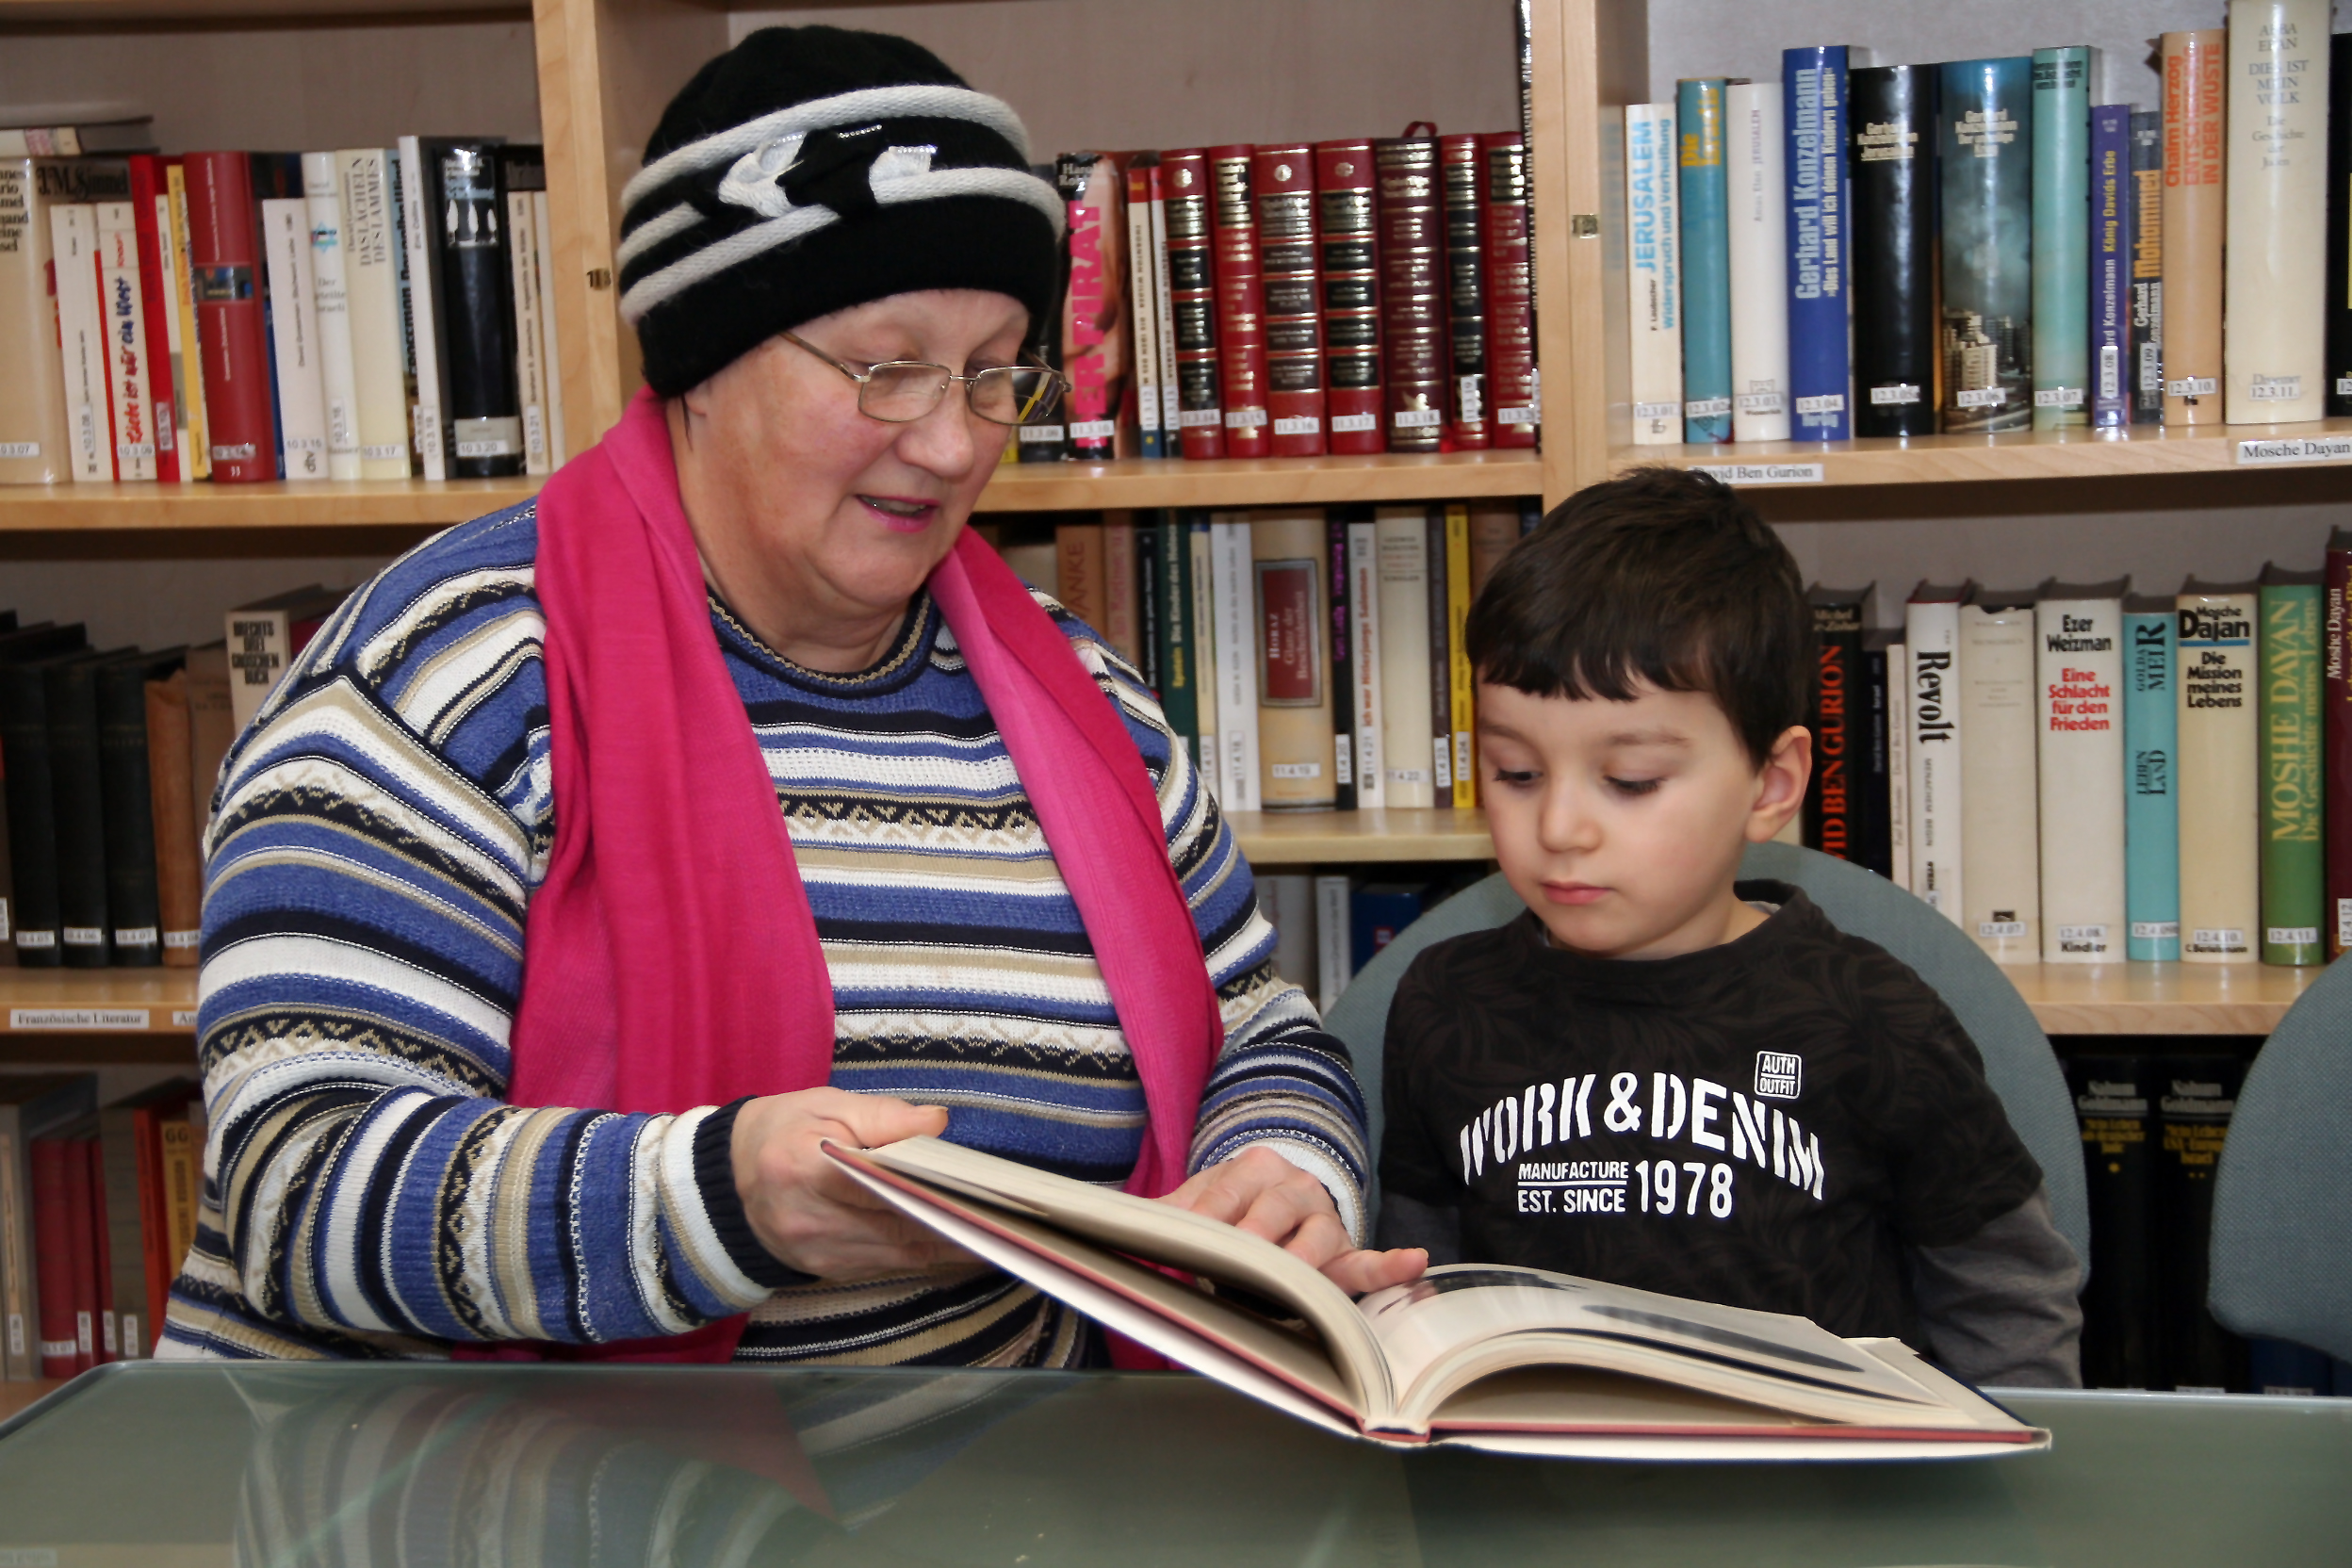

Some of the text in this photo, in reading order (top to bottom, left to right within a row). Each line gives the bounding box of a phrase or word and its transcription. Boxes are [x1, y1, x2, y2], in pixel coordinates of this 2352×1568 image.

[2287, 59, 2309, 73] IST
[2166, 55, 2182, 124] Herzog
[1680, 133, 1700, 167] Die
[1751, 109, 1761, 165] JERUSALEM
[1821, 109, 1838, 155] Kindern
[2202, 121, 2219, 161] DER
[368, 157, 384, 229] LAMMES
[1792, 70, 1821, 300] Gerhard Konzelmann
[1821, 155, 1838, 193] deinen
[2202, 164, 2219, 185] IN
[1633, 121, 1657, 273] JERUSALEM
[1821, 195, 1838, 213] ich
[1658, 119, 1675, 330] Widerspruch und Verheißung
[1822, 215, 1838, 236] will
[2102, 150, 2118, 327] Konzelmann König Davids Erbe
[2133, 169, 2161, 278] Mohammed
[1068, 200, 1105, 346] PIRAT
[1822, 238, 1838, 265] Land
[2134, 282, 2149, 327] Gerhard
[304, 450, 317, 473] dtv
[2244, 440, 2352, 460] Mosche Dayan
[1737, 466, 1813, 479] Ben Gurion
[1066, 544, 1091, 618] ANKE
[1358, 567, 1369, 619] Salomon
[1168, 564, 1186, 688] Epstein Die Kinder des
[2062, 613, 2093, 632] Ezer
[2178, 609, 2250, 642] Dajan
[2197, 606, 2242, 618] Mosche
[2326, 588, 2344, 680] Moshe Dayan
[1269, 614, 1281, 659] HORAZ
[1282, 607, 1296, 665] Glanz der
[1295, 590, 1309, 680] Bescheidenheit
[1360, 622, 1372, 686] Hitlerjunge
[2047, 633, 2113, 652] Weizman
[2135, 621, 2166, 692] MEIR
[2061, 667, 2097, 682] Eine
[2135, 648, 2147, 692] GOLDA
[2186, 666, 2243, 679] Mission
[2201, 651, 2227, 665] Die
[1916, 650, 1955, 744] Revolt
[2049, 684, 2111, 699] Schlacht
[2051, 700, 2108, 714] für den
[2186, 680, 2243, 694] meines
[2187, 694, 2243, 708] Lebens
[1820, 645, 1847, 814] BEN GURION
[2050, 716, 2110, 731] Frieden
[2269, 600, 2302, 841] MOSHE DAYAN
[2299, 597, 2319, 841] Die Geschichte meines Lebens
[2148, 749, 2166, 796] LAND
[1924, 759, 1935, 847] MENACHEM BEGIN
[2061, 941, 2107, 953] Kindler
[18, 1009, 142, 1024] Französische Literatur
[1761, 1054, 1796, 1074] AUTH
[1759, 1078, 1796, 1096] OUTFIT
[1460, 1071, 1825, 1200] WORK & DENIM
[1517, 1161, 1629, 1180] MANUFACTURE
[1517, 1159, 1734, 1218] EST. SINCE 1978
